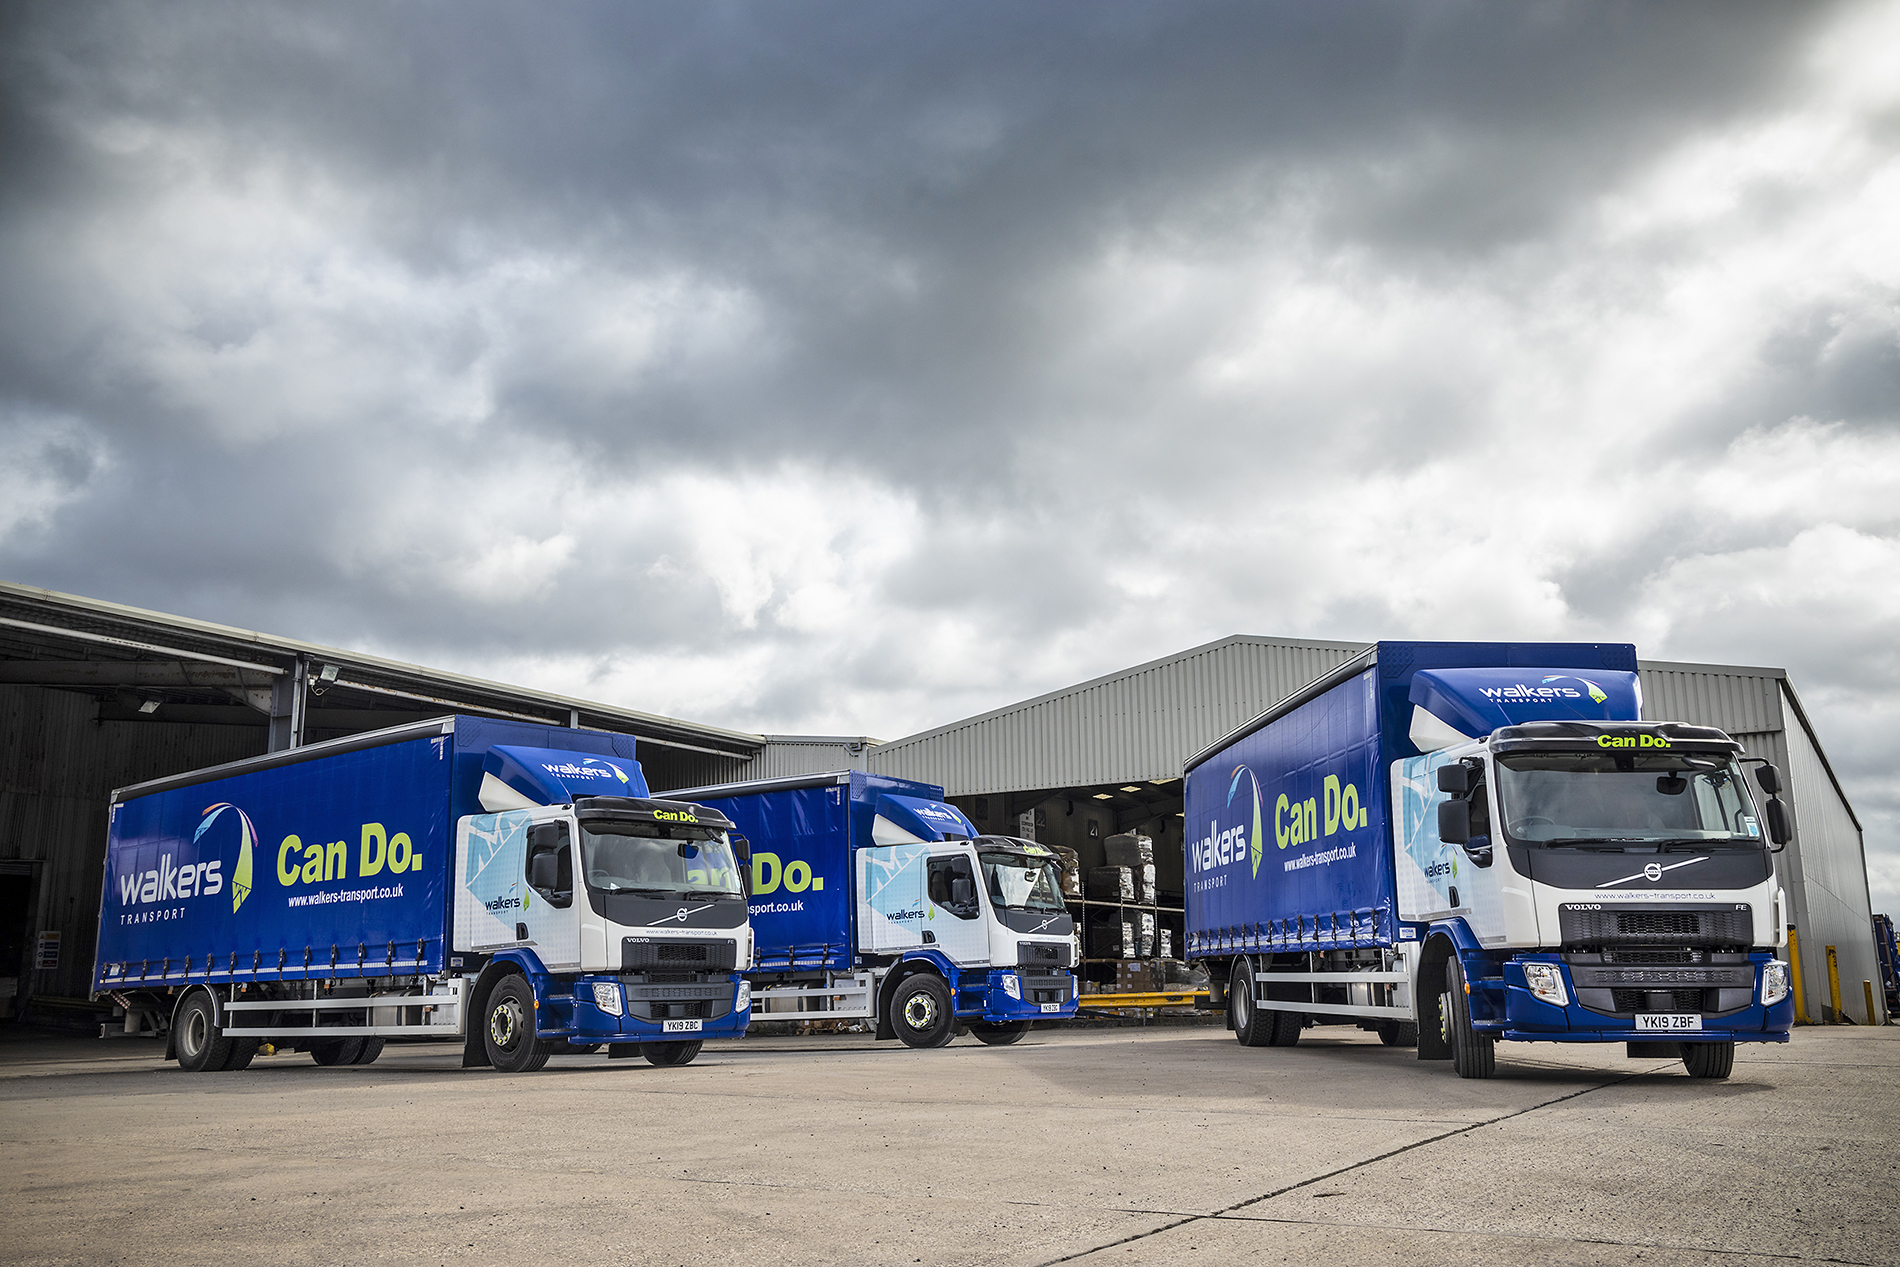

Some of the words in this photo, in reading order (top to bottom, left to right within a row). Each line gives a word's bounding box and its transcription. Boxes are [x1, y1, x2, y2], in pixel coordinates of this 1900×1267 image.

[1479, 684, 1581, 698] walkers
[1597, 734, 1636, 748] Can
[1639, 734, 1671, 748] Do.
[541, 763, 612, 778] walkers
[653, 809, 678, 821] Can
[679, 811, 699, 823] Do.
[1275, 793, 1317, 850] Can
[1323, 774, 1367, 837] Do.
[277, 834, 347, 887] Can
[359, 822, 423, 878] Do.
[1191, 819, 1246, 874] walkers
[1284, 842, 1357, 872] www.walkers-transport.co.uk
[752, 852, 824, 895] Do.
[1424, 861, 1451, 878] walkers
[120, 853, 223, 906] walkers
[1193, 874, 1228, 893] TRANSPORT
[288, 883, 404, 908] www.walkers-transport.co.uk
[485, 896, 521, 910] walkers
[1594, 892, 1716, 900] www.walkers-transport.co.uk
[747, 900, 804, 916] sport.co.uk
[886, 909, 926, 920] walkers
[120, 907, 187, 926] TRANSPORT
[667, 1021, 684, 1031] YK19
[685, 1020, 699, 1030] ZBC
[1643, 1016, 1669, 1028] YK19
[1672, 1016, 1694, 1028] ZBF
